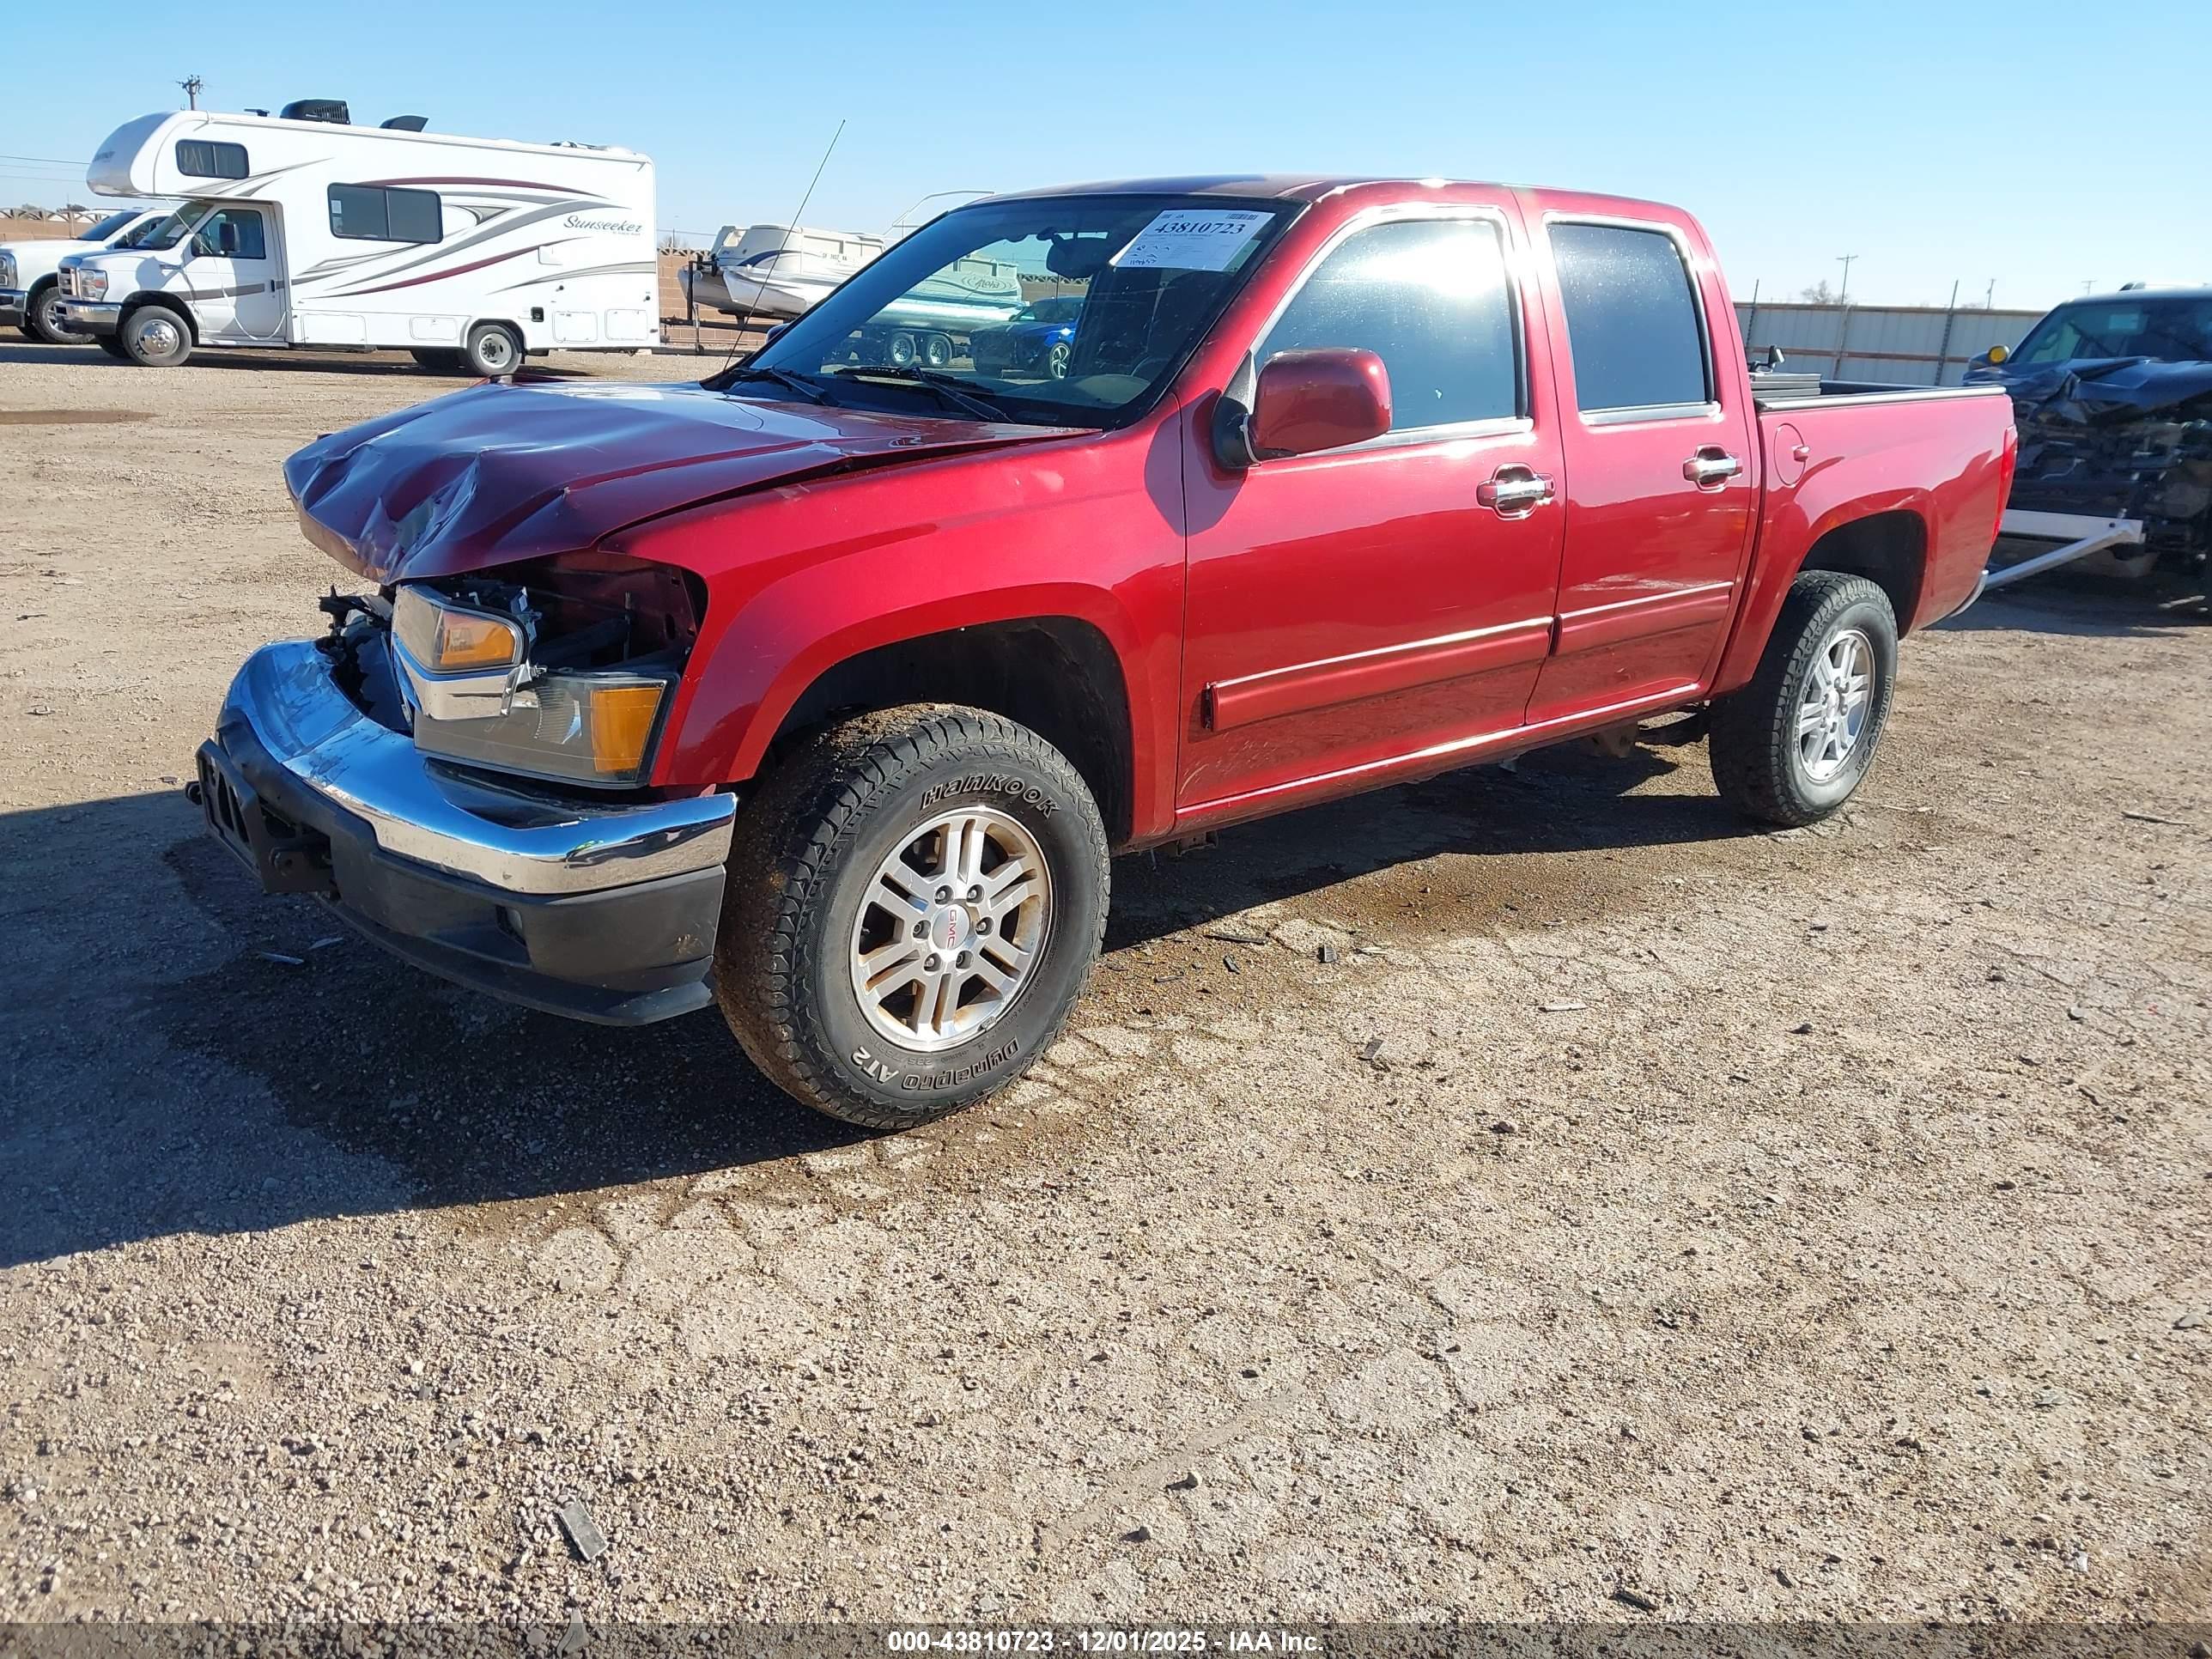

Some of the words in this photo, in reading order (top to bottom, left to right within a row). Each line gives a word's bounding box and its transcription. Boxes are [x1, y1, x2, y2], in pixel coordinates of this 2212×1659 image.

[563, 215, 642, 233] Sunseeker
[1154, 222, 1246, 234] 43810723
[947, 909, 957, 949] GMC
[850, 1046, 900, 1085] AT2
[902, 1036, 1021, 1091] Dynapro
